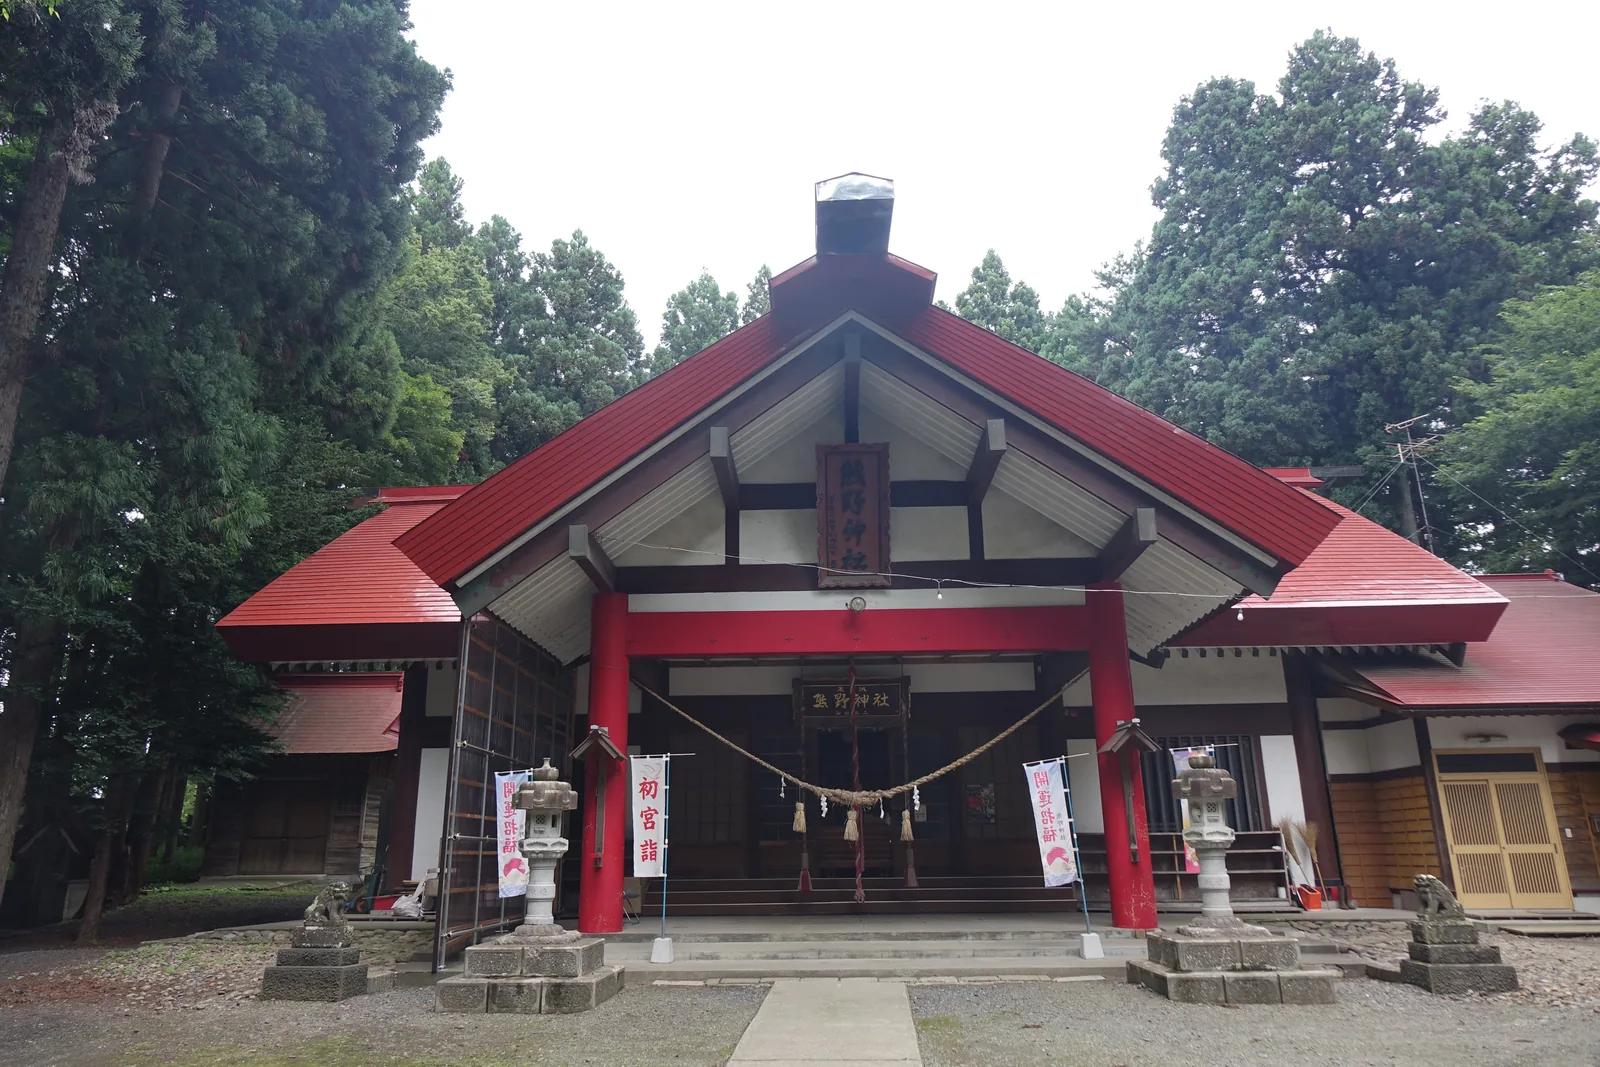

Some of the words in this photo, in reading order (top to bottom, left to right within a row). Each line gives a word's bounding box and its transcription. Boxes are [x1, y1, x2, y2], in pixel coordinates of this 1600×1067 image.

[812, 692, 890, 708] 熊野神社
[639, 777, 659, 863] 初宮詣
